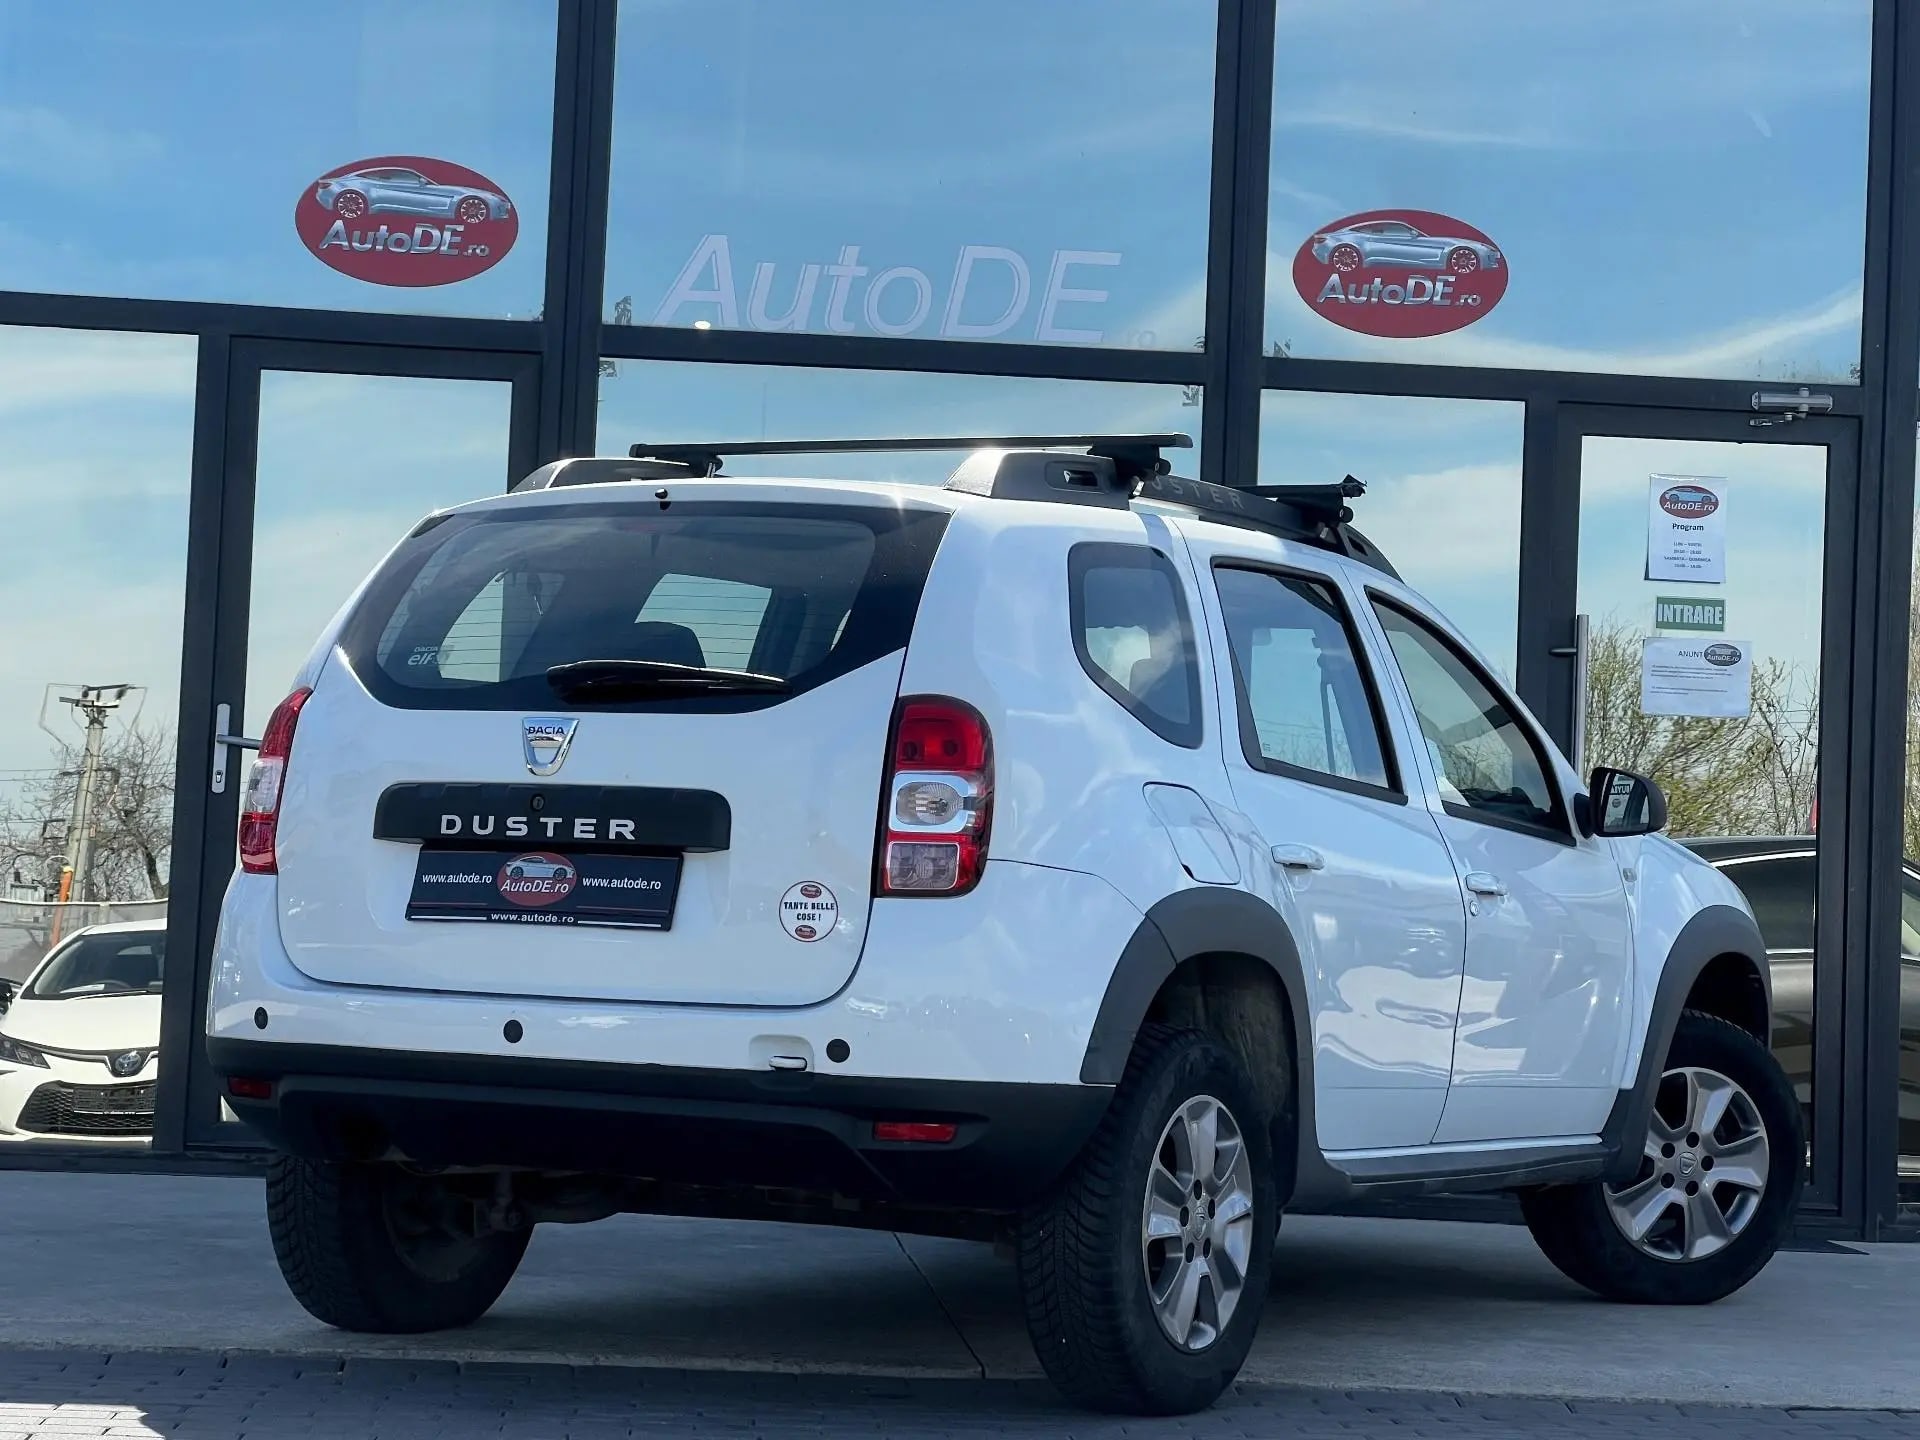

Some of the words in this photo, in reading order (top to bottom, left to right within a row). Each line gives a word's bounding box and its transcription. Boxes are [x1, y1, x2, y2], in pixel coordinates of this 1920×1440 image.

[1151, 475, 1245, 509] USTER
[1672, 523, 1705, 532] Program
[1657, 603, 1723, 625] INTRARE
[408, 652, 435, 665] elf
[528, 727, 565, 735] DACIA
[440, 814, 637, 841] DUSTER
[422, 872, 493, 885] www.autode.ro
[582, 875, 662, 891] www.autode.ro
[500, 879, 570, 894] AutoDE.ro
[784, 902, 808, 910] TANTE
[490, 911, 574, 924] www.autode.ro
